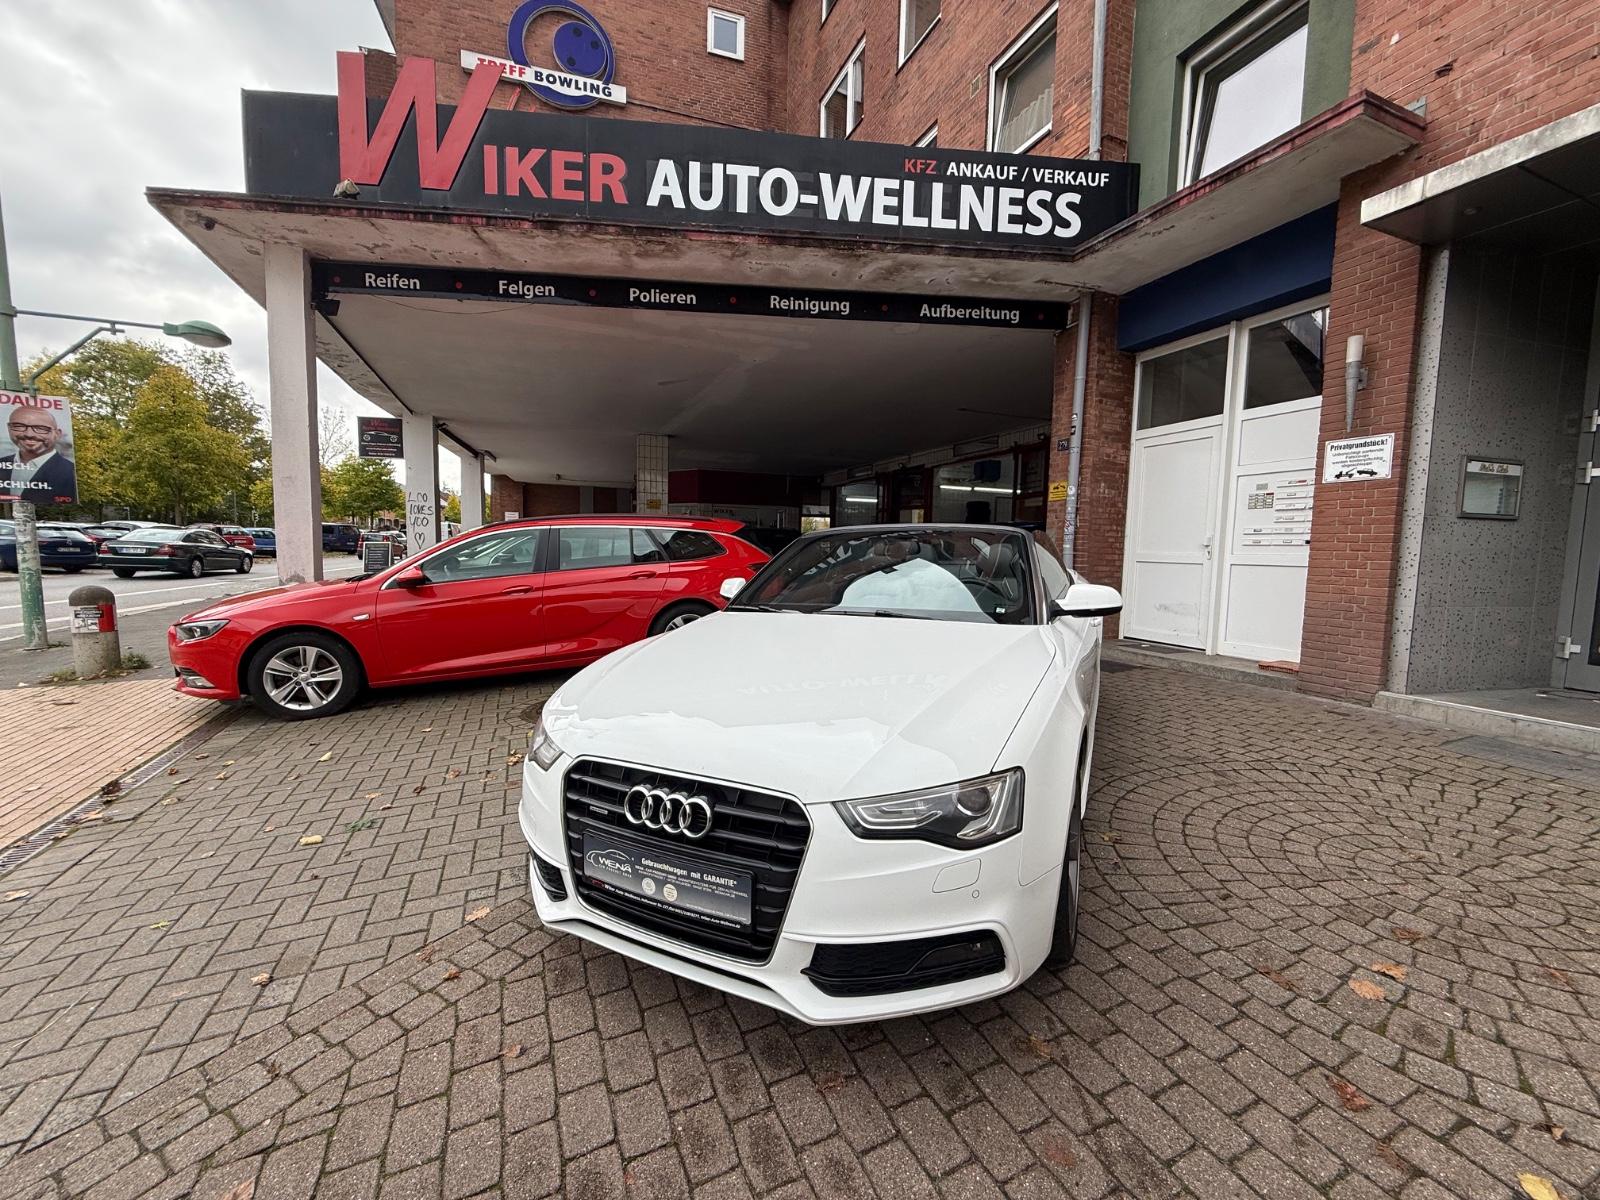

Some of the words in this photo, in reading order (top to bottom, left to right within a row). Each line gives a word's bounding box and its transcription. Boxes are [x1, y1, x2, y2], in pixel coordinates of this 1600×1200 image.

[534, 70, 612, 98] BOWLING
[337, 51, 629, 205] WIKER
[646, 158, 1082, 239] AUTO-WELLNESS
[904, 158, 937, 175] KFZ
[946, 162, 1018, 182] ANKAUF
[1033, 168, 1110, 188] VERKAUF
[364, 272, 421, 290] Reifen
[498, 280, 556, 299] Felgen
[629, 287, 697, 305] Polieren
[770, 295, 851, 315] Reinigung
[919, 304, 1020, 324] Aufbereitung
[0, 393, 63, 411] DAUDE
[1330, 438, 1388, 451] Privatgrundstück!
[0, 461, 34, 471] ISCH.
[641, 857, 688, 876] Gebrauchtwagen
[690, 871, 701, 880] mit
